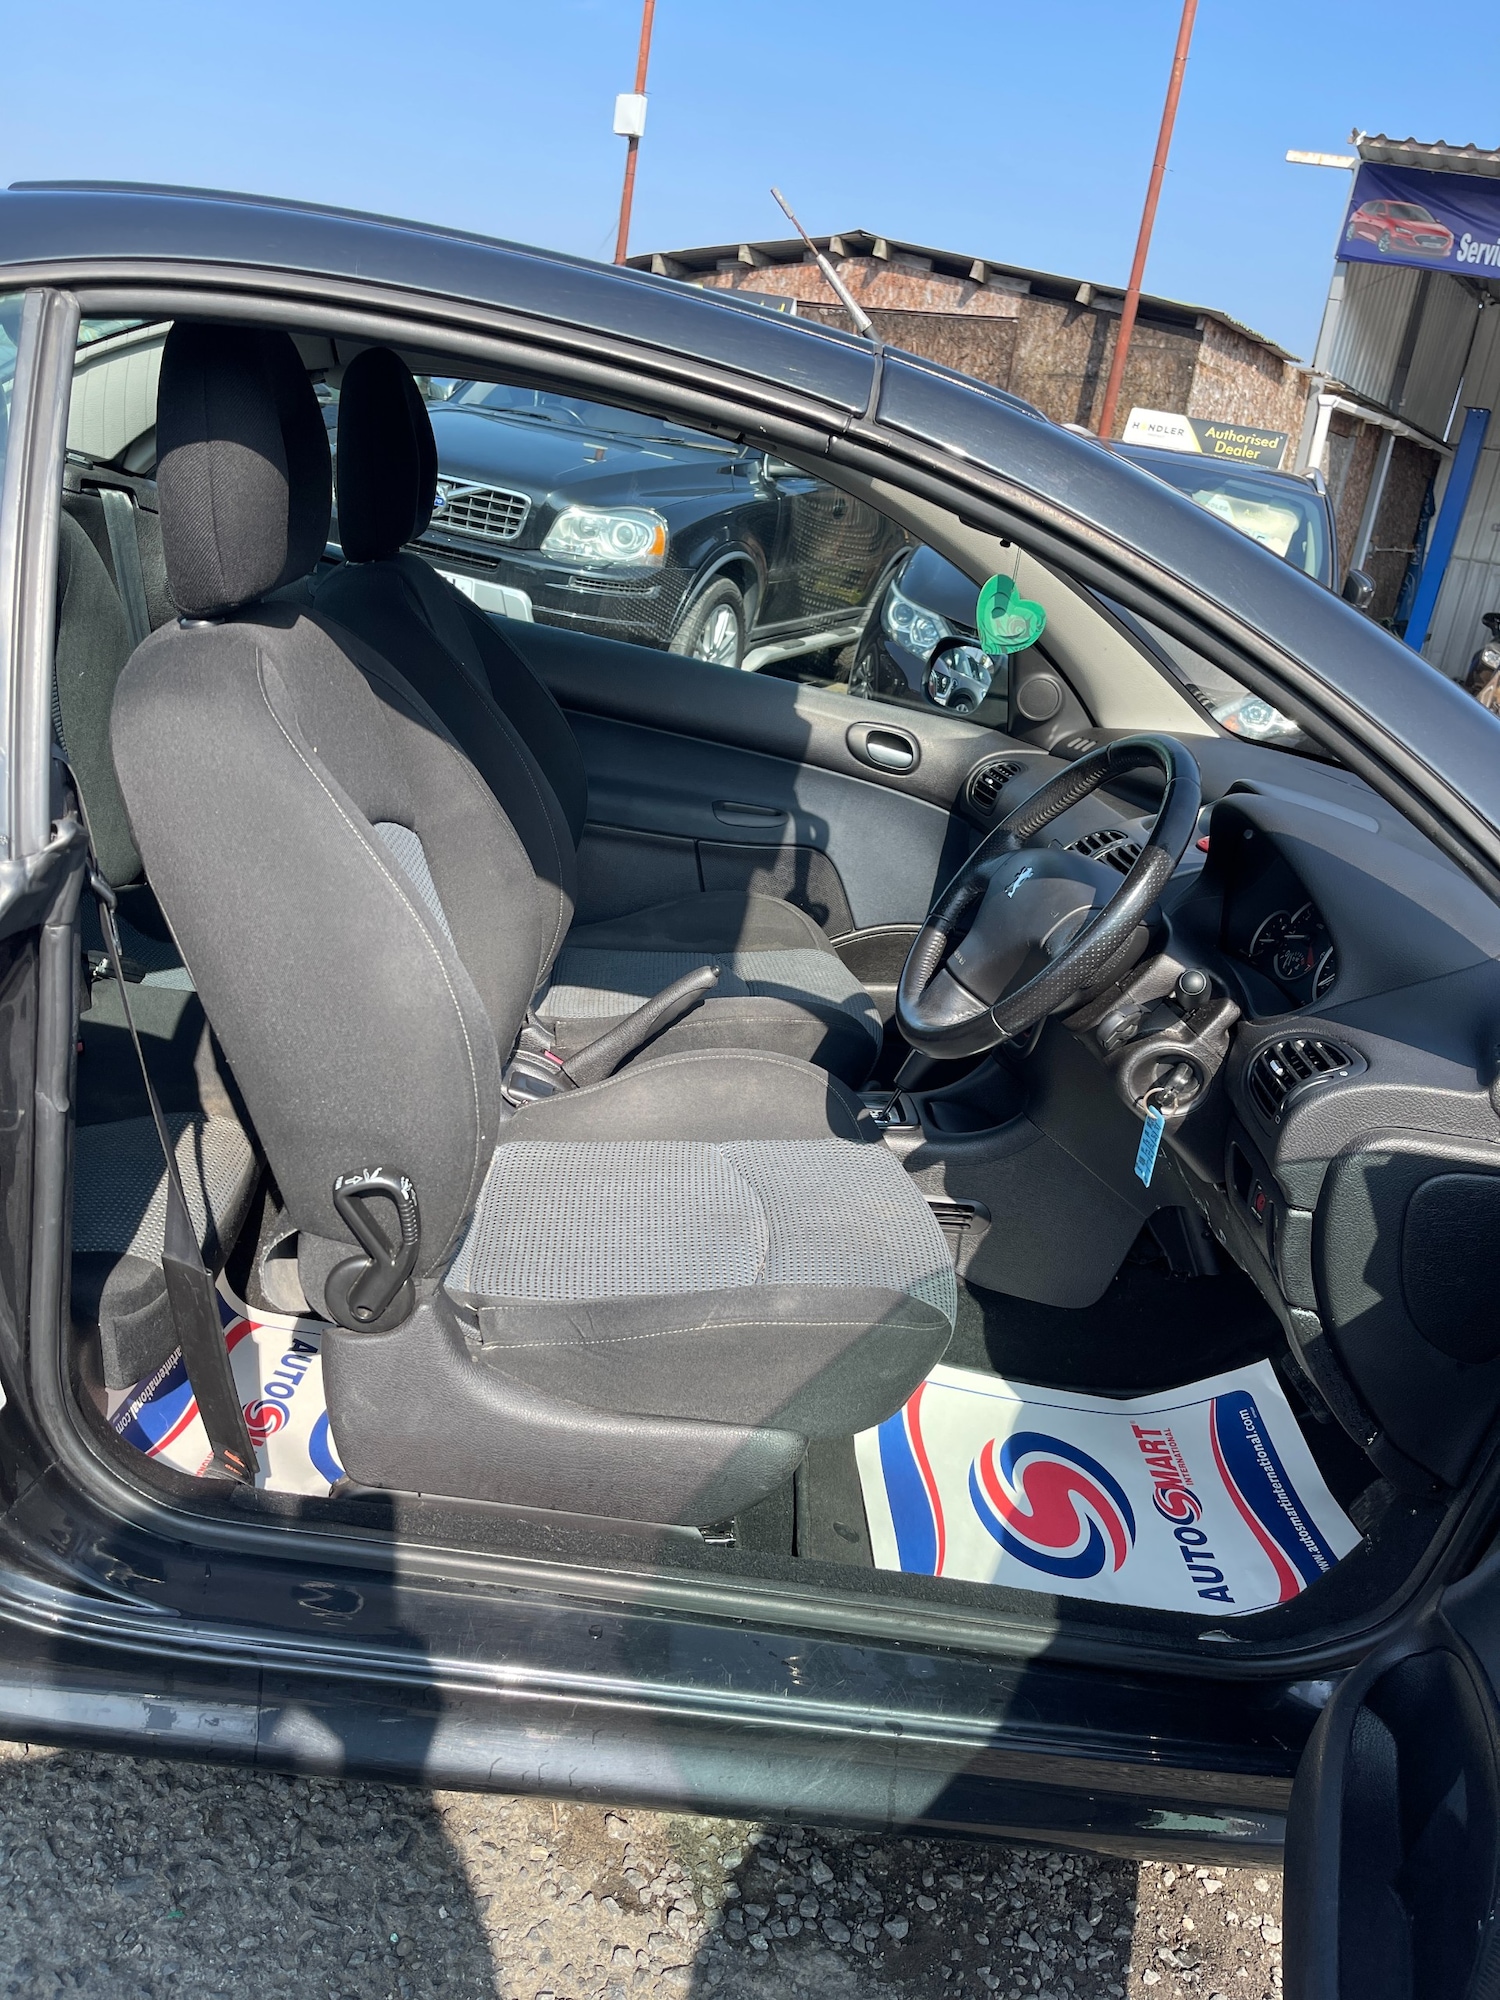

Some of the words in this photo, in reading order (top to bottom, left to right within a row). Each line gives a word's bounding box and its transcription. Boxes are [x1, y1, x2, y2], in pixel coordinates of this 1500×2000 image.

[1205, 426, 1280, 449] Authorised
[1214, 441, 1261, 460] Dealer
[242, 1338, 319, 1447] AUTOS
[1164, 1427, 1195, 1486] INTERNATIONAL
